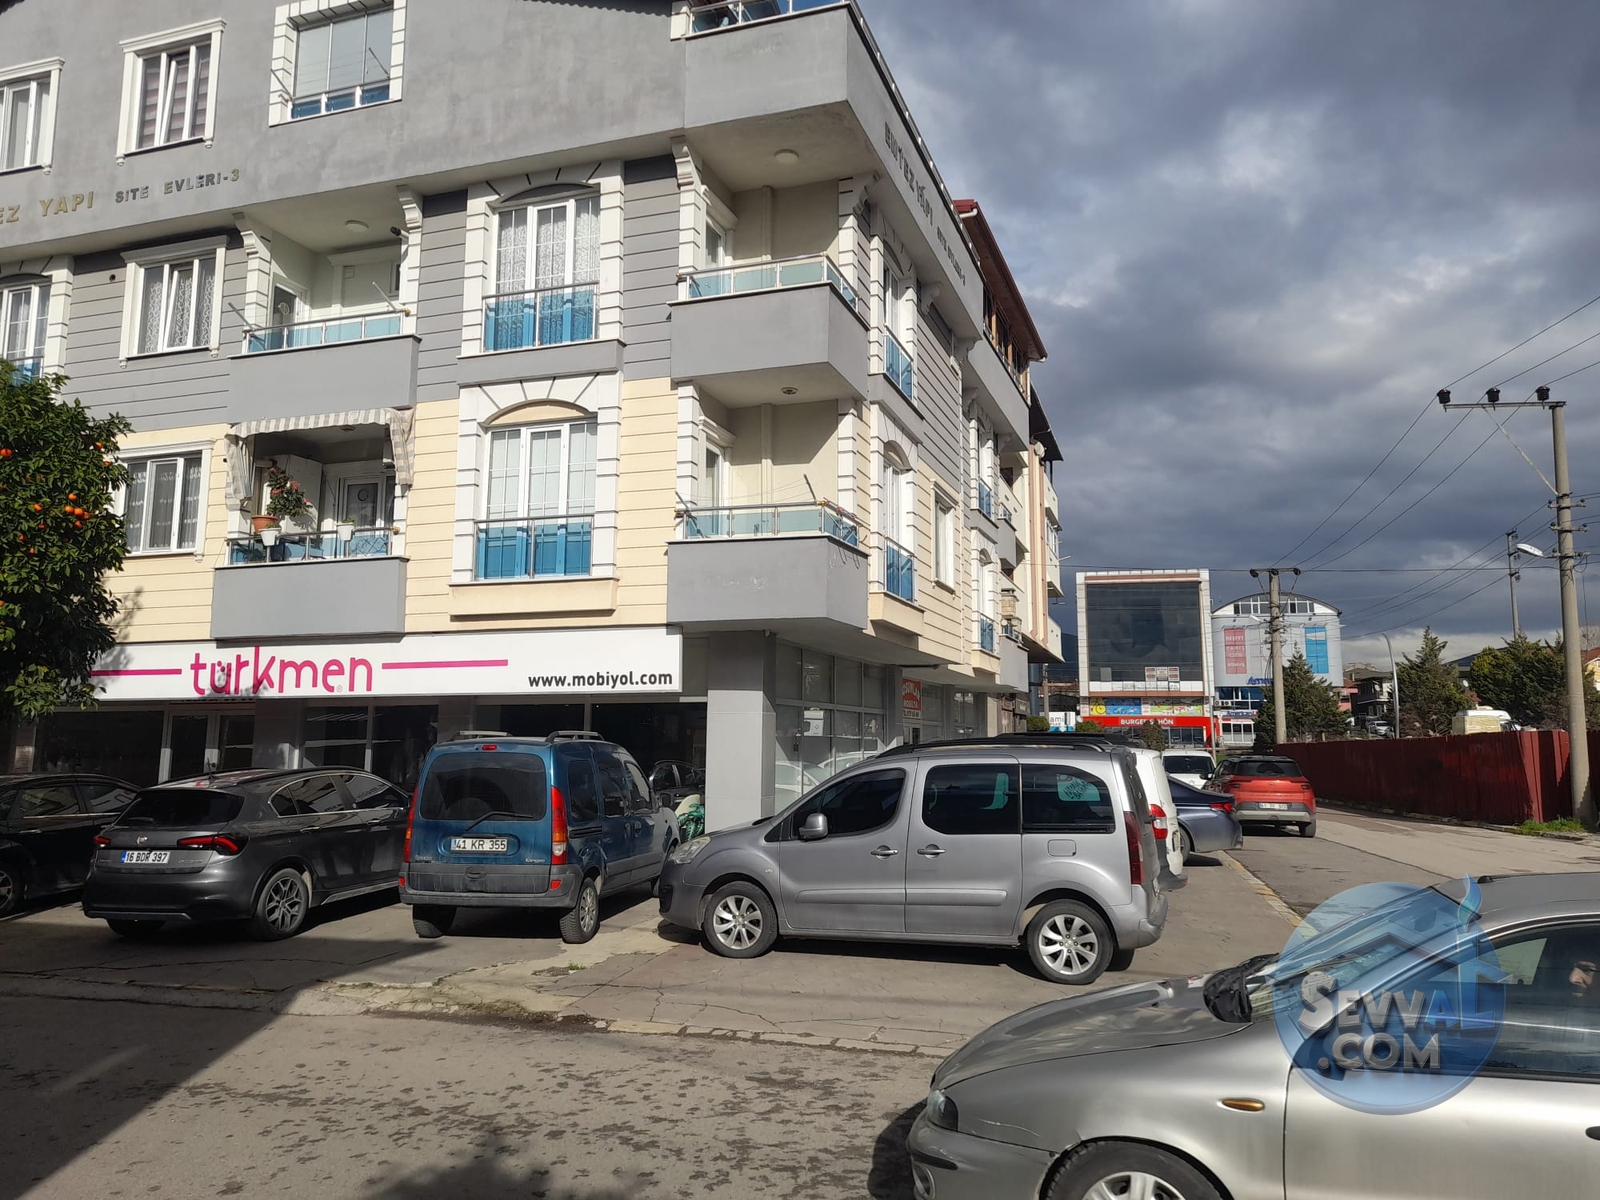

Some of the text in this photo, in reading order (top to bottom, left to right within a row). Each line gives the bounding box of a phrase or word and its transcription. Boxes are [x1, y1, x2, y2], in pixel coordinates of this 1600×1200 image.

[40, 191, 95, 218] YAPI
[190, 645, 373, 696] türkmen
[528, 670, 673, 689] www.mobiyol.com
[1149, 717, 1174, 725] SHÖN
[456, 839, 506, 850] 41 KR 355
[126, 852, 135, 862] 16
[135, 852, 151, 862] BDR
[152, 852, 168, 862] 397
